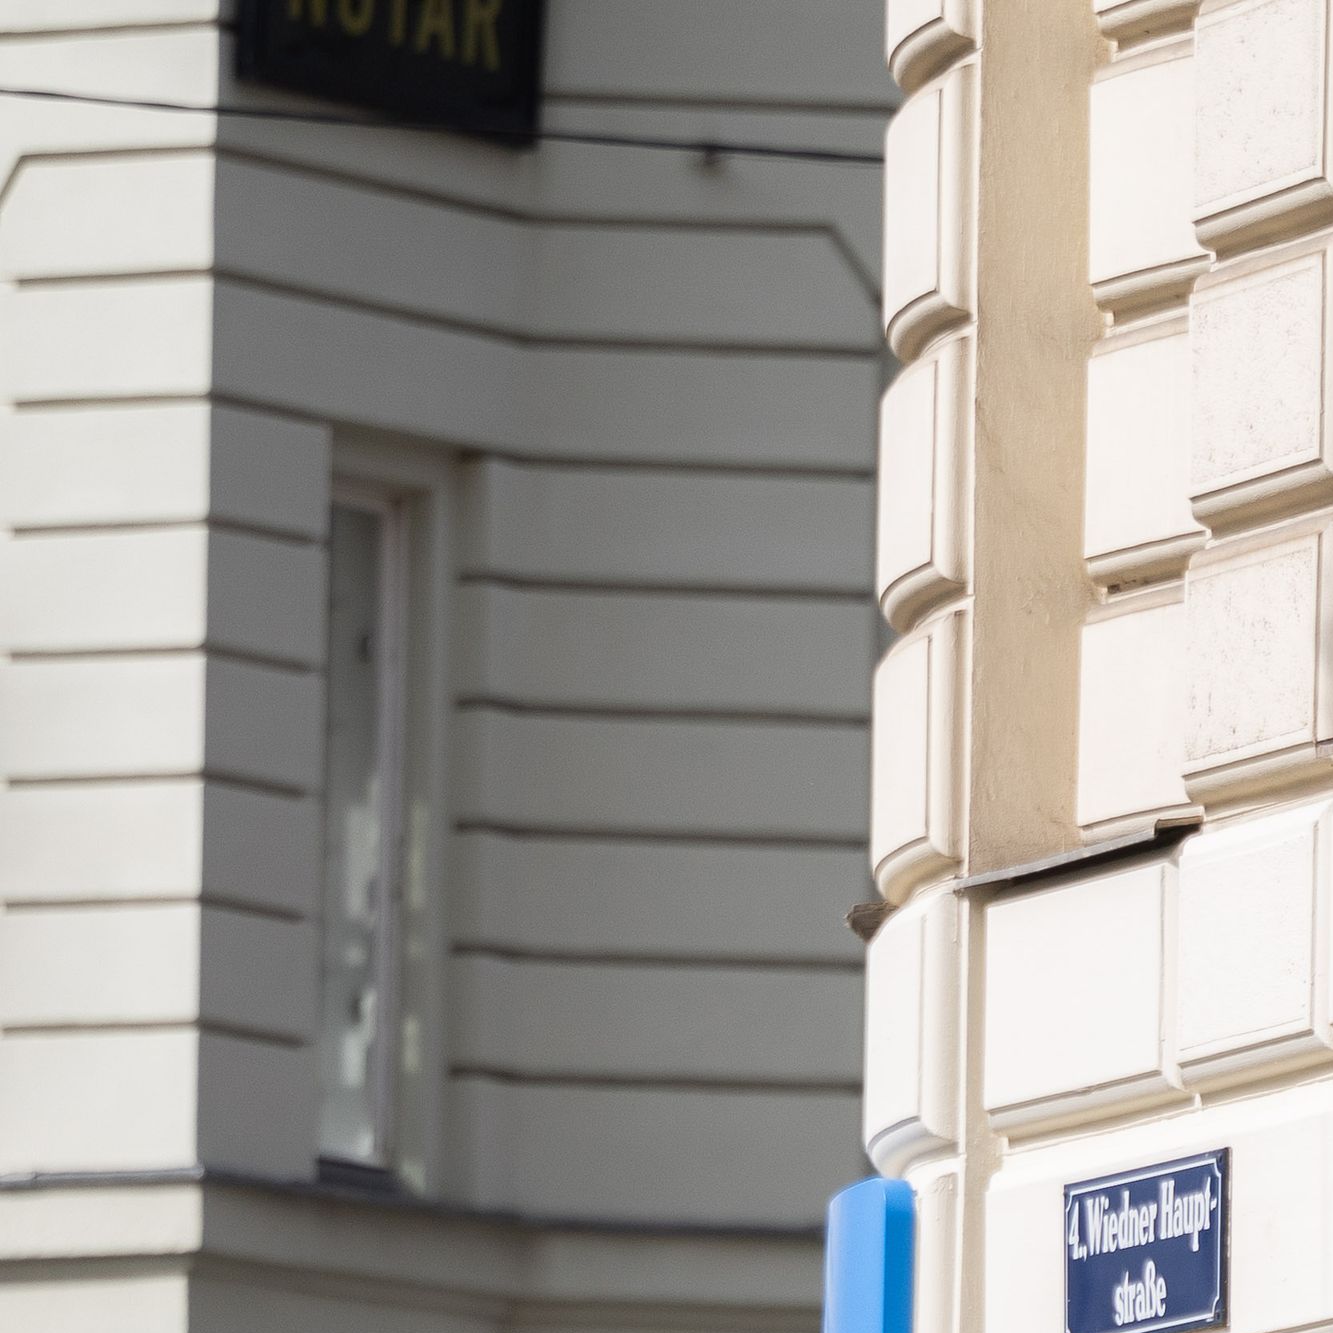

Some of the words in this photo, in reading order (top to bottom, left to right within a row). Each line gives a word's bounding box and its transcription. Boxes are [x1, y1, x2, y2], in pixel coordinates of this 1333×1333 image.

[1088, 1189, 1158, 1257] Wiedner
[1160, 1176, 1217, 1252] Haupt-
[1114, 1260, 1167, 1327] straße
